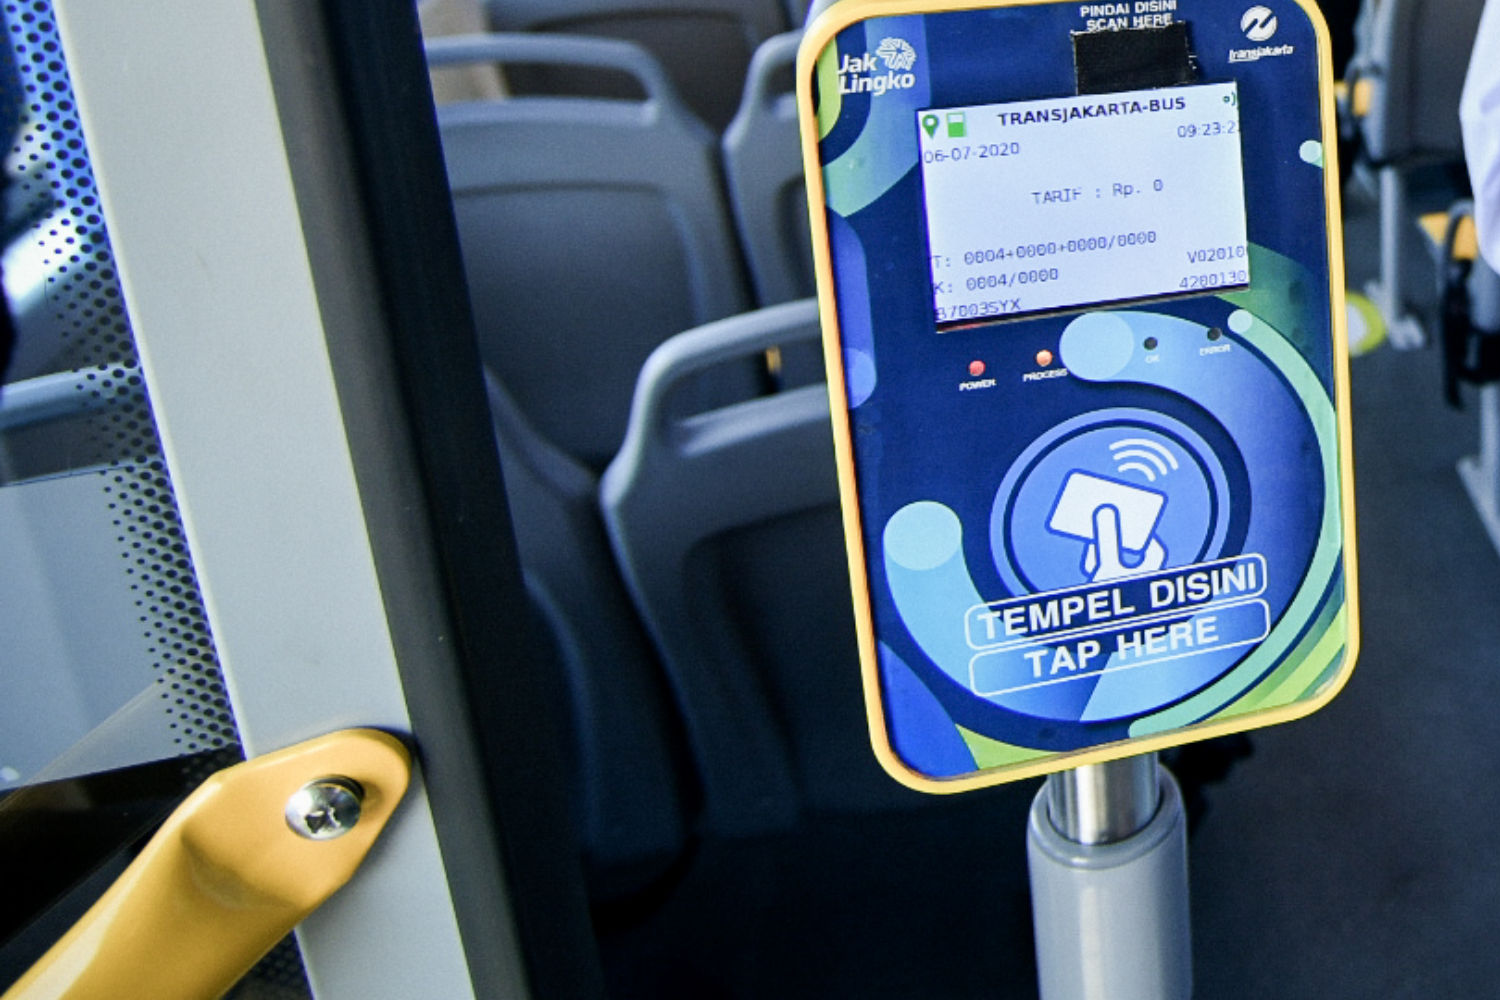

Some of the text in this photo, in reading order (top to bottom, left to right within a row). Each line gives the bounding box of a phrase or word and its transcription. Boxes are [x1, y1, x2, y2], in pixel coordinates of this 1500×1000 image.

[1079, 2, 1131, 18] PINDAI
[1086, 12, 1174, 32] SCAN HERE
[1228, 44, 1294, 63] transjakarta
[836, 53, 877, 75] Jak
[838, 69, 916, 96] Lingko
[997, 96, 1186, 127] TRANSJAKARTA-BUS
[1176, 119, 1238, 139] 09:23:2
[923, 141, 1020, 164] 06-07-2020
[1031, 187, 1082, 206] TARIF
[1111, 181, 1142, 199] Rp.
[1153, 178, 1164, 193] 0
[932, 254, 952, 269] T:
[933, 280, 953, 295] K:
[958, 378, 997, 392] POWER
[1021, 367, 1069, 383] PROCESS
[978, 561, 1257, 641] TEMPEL DISINI
[1024, 615, 1220, 679] TAP HERE
